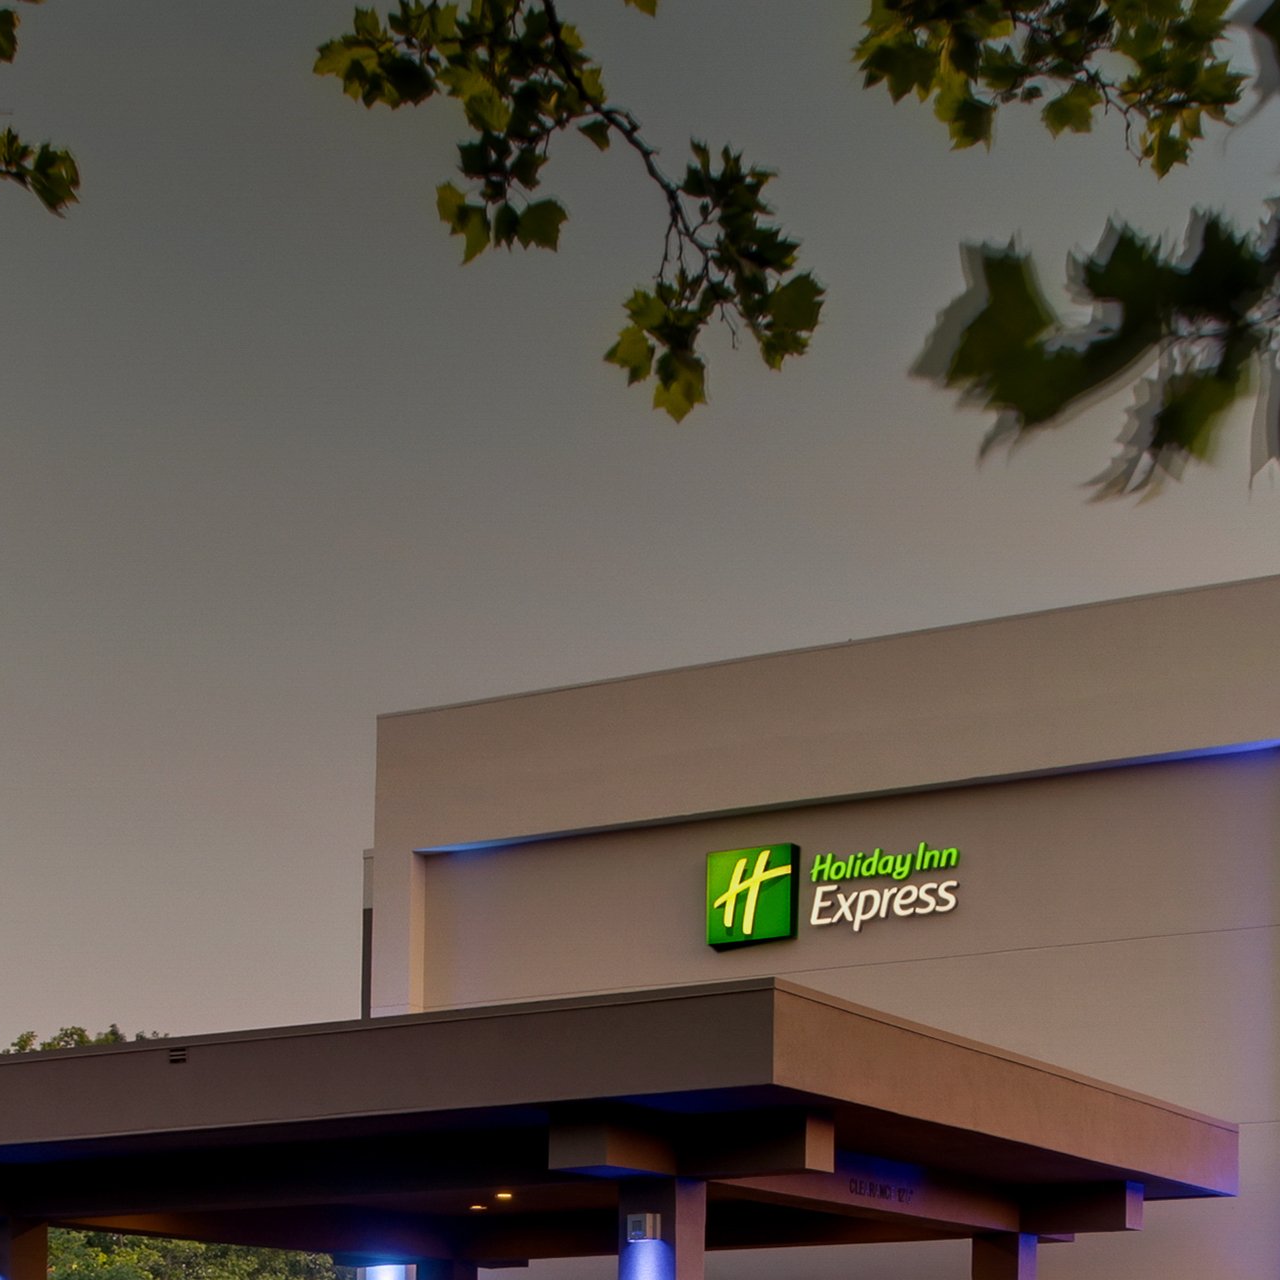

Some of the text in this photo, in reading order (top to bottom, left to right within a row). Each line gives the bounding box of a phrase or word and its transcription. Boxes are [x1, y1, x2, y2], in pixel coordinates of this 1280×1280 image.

[811, 841, 958, 882] Holiday Inn
[713, 850, 792, 935] H
[810, 880, 958, 932] Express
